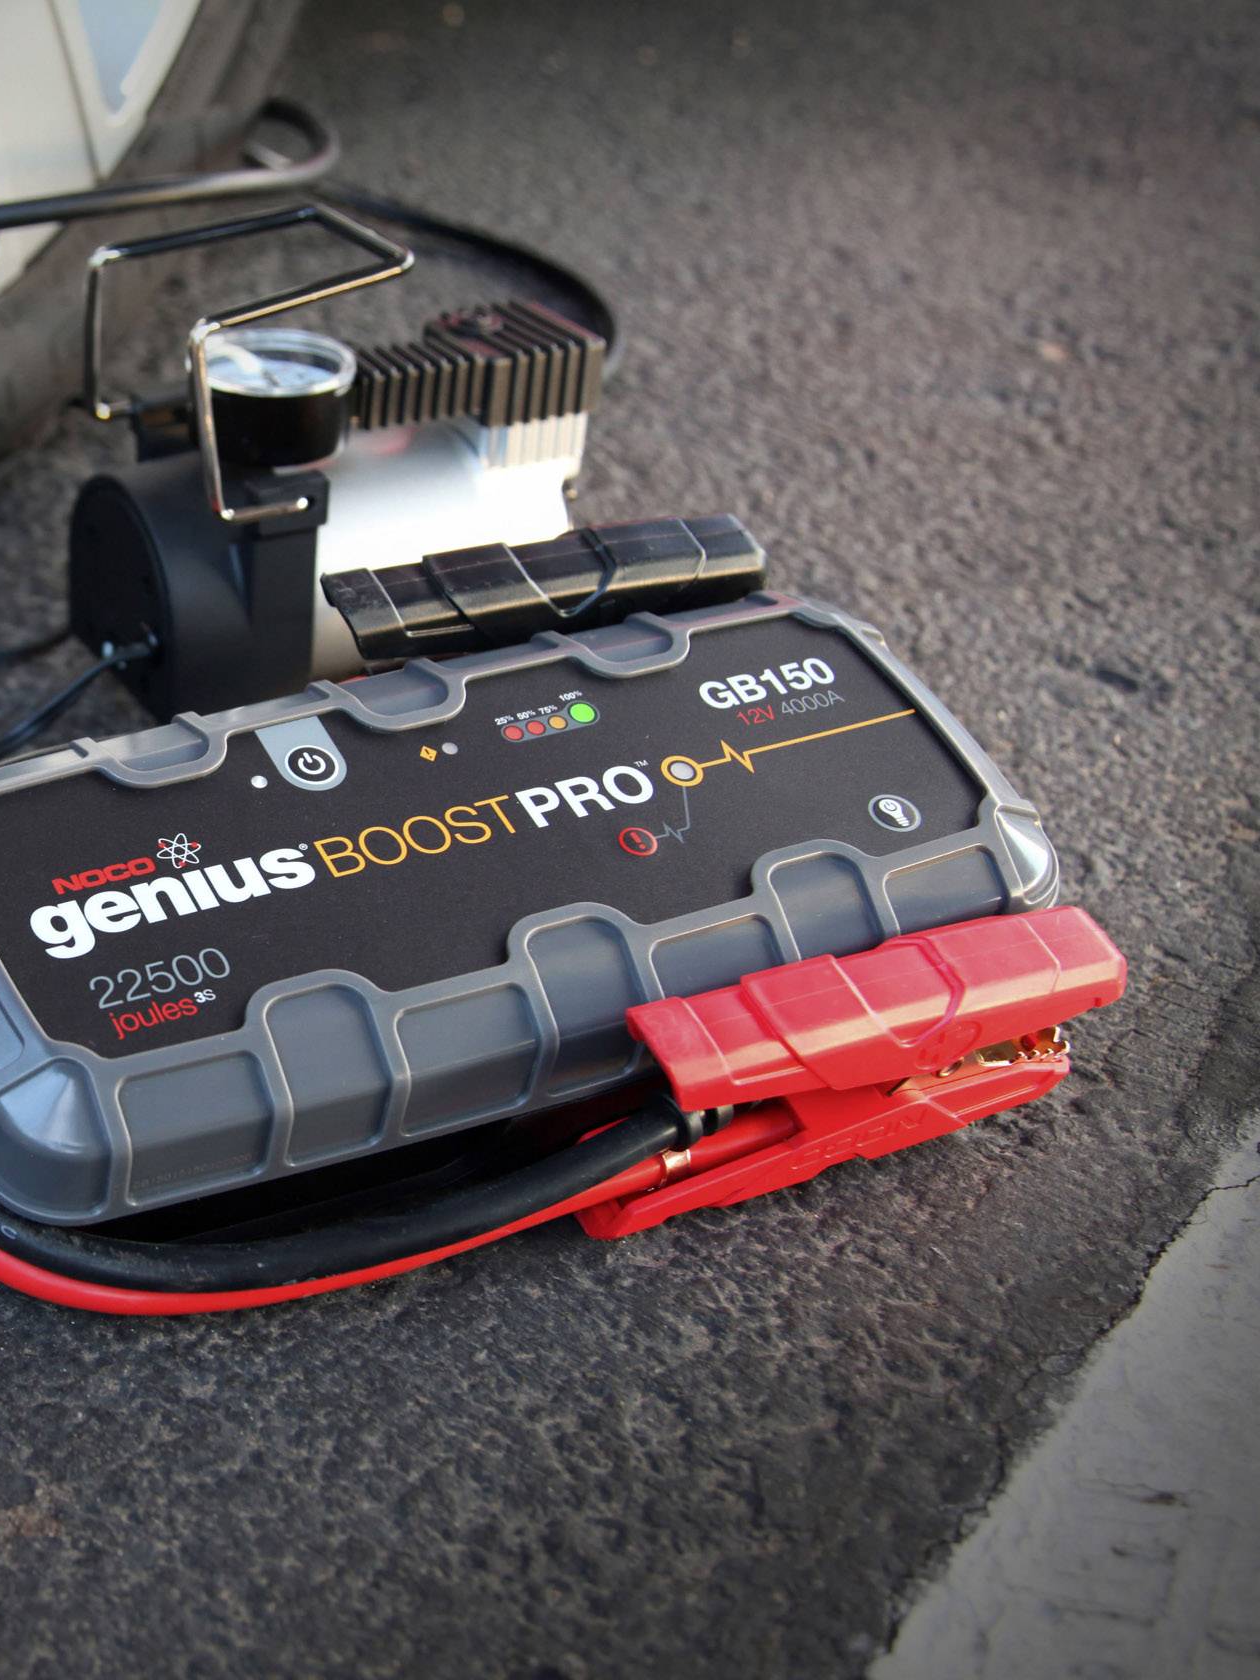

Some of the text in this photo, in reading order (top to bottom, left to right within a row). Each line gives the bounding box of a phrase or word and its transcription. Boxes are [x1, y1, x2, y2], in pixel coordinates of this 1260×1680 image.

[699, 658, 835, 709] GB150
[494, 715, 514, 726] 25%
[559, 690, 583, 702] 100%
[736, 689, 846, 726] 12V 4000A
[51, 857, 157, 895] NOCO
[89, 948, 230, 1009] 22500
